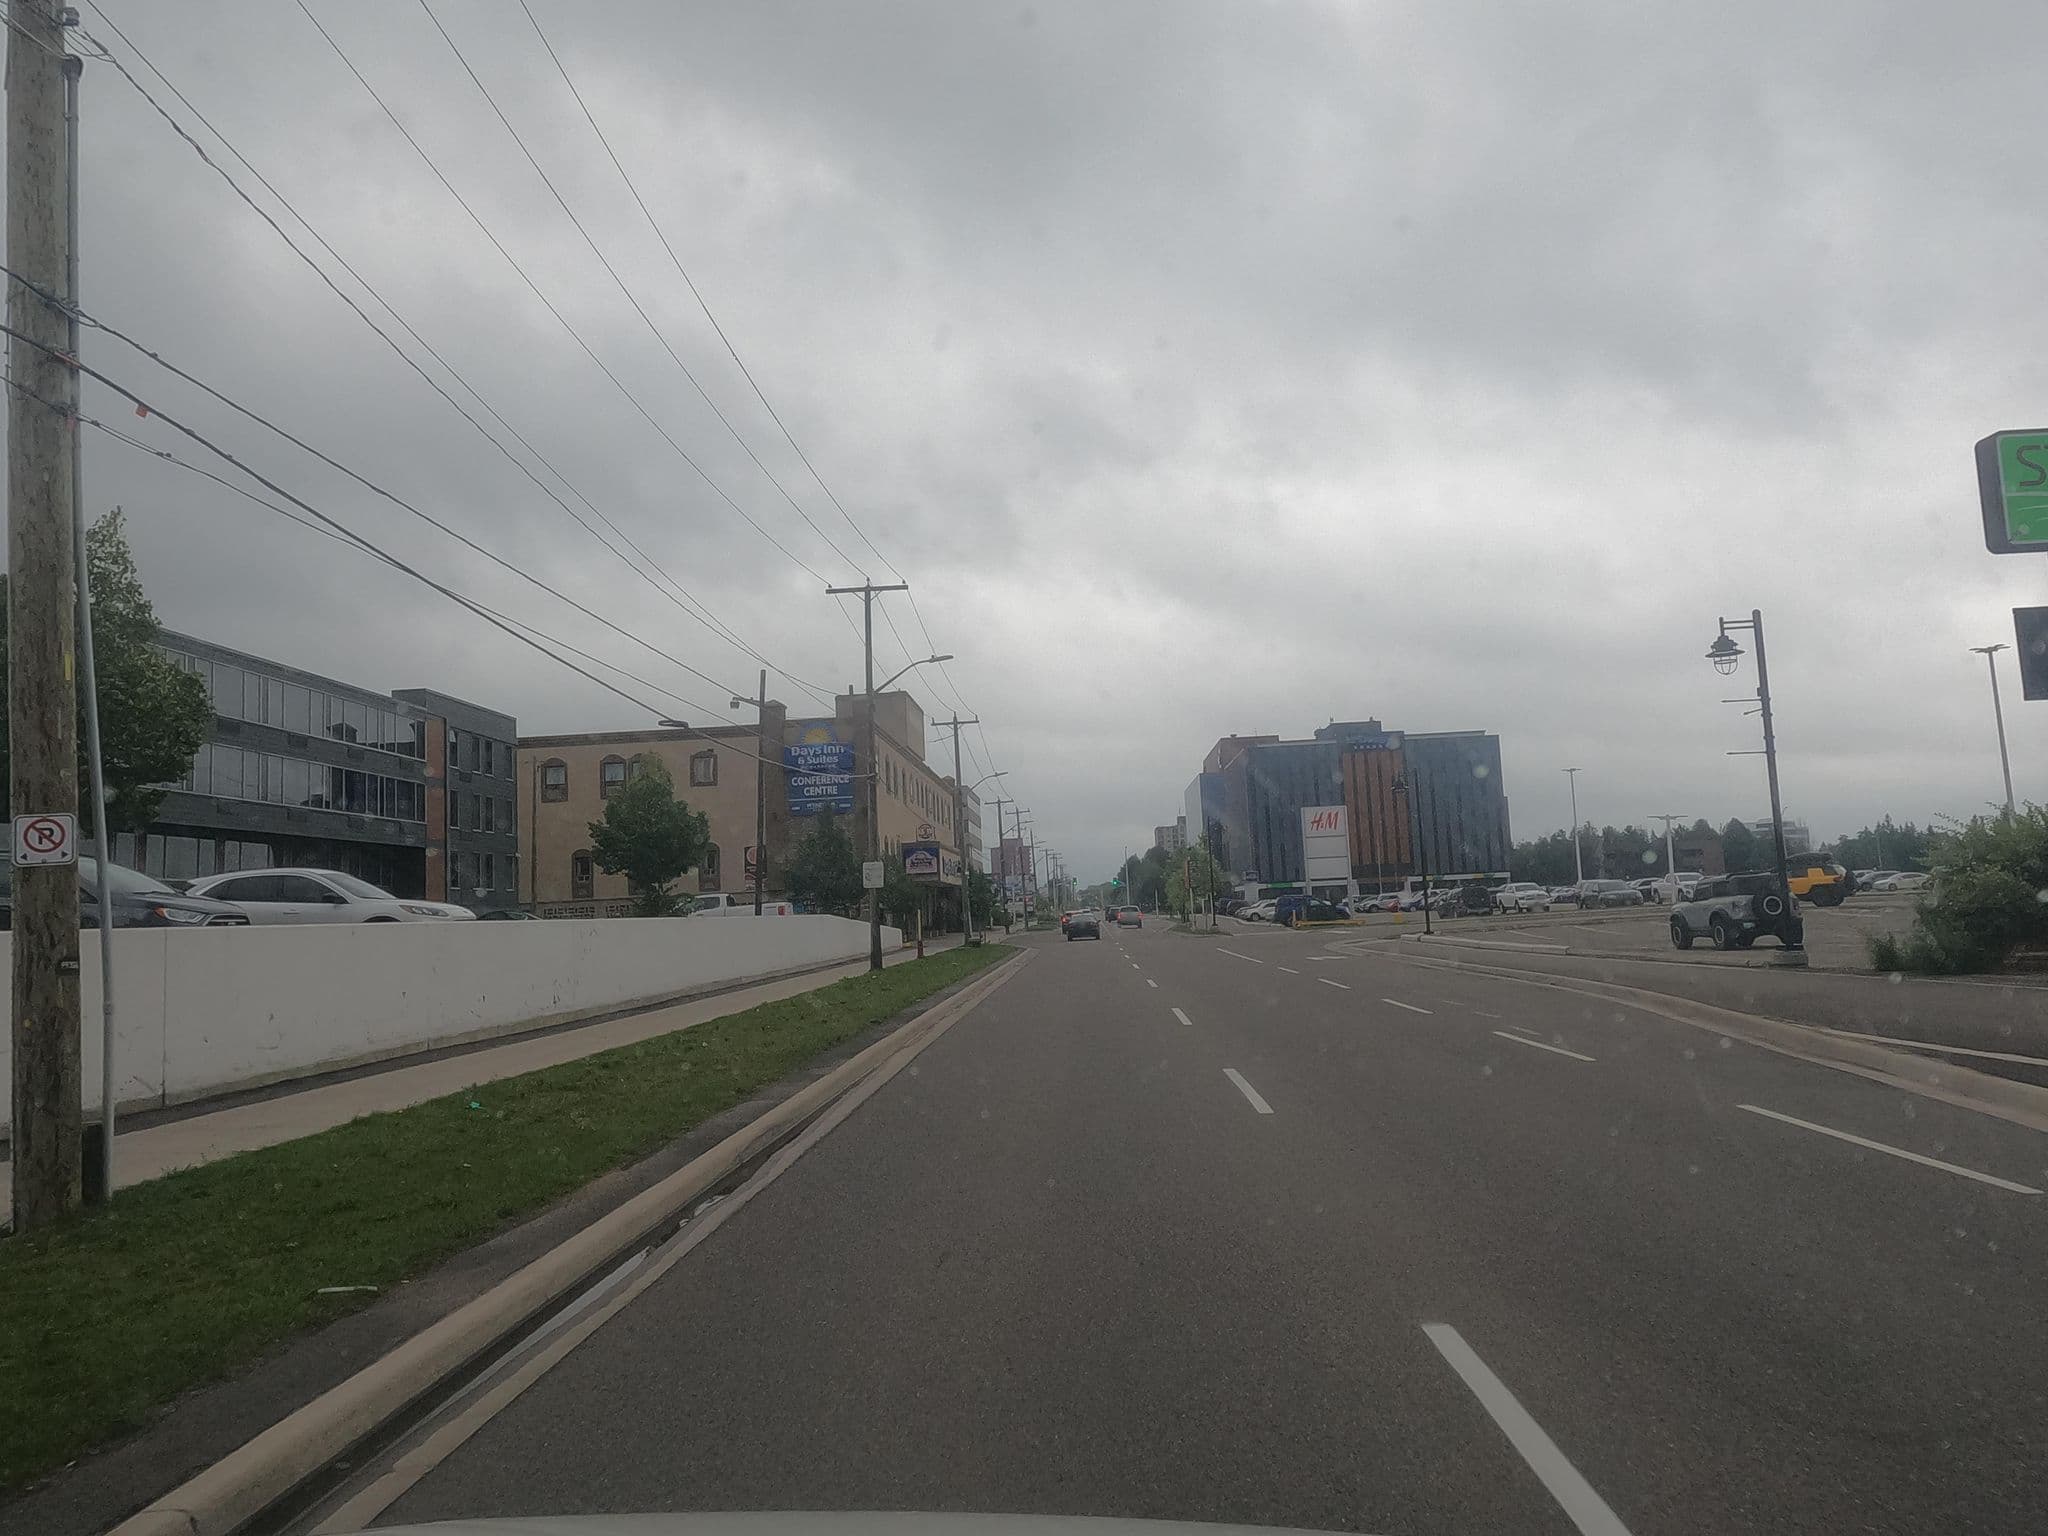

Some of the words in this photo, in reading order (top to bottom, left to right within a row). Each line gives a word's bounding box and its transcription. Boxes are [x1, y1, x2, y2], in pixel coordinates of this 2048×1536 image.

[2016, 444, 2048, 487] S
[791, 746, 822, 757] Days
[823, 744, 845, 754] Inn
[807, 755, 839, 764] Suites
[791, 775, 850, 786] CONFERENCE
[804, 786, 838, 796] CENTRE
[1310, 811, 1339, 831] H&M
